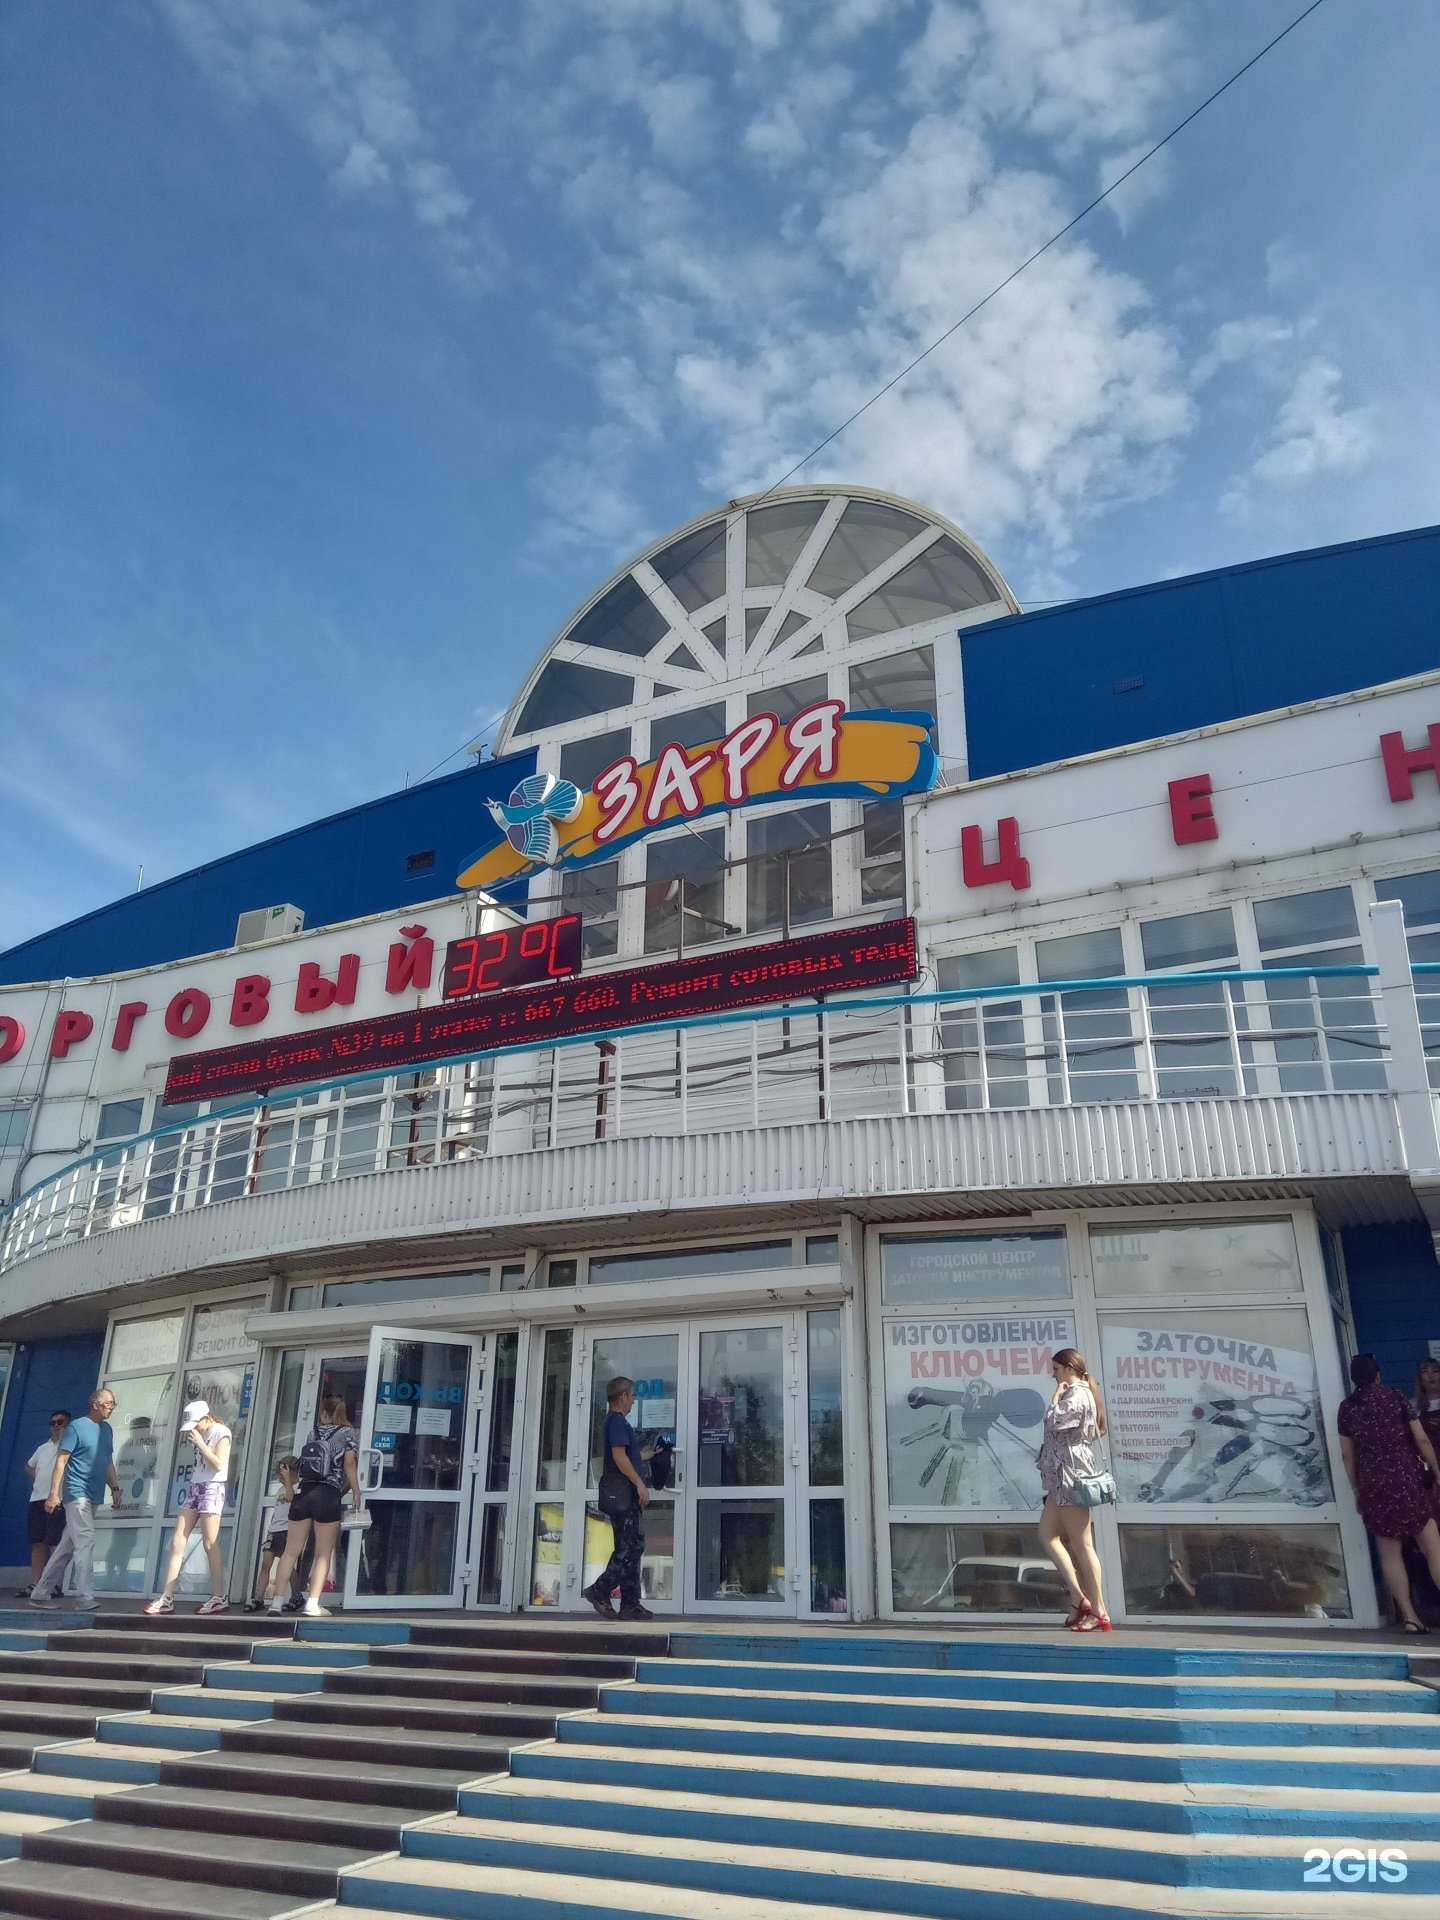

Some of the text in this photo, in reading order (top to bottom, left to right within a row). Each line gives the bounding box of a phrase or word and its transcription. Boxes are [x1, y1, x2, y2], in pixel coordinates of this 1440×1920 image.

[592, 698, 846, 843] ЗАРЯ
[631, 973, 723, 1004] Ремонт
[729, 953, 844, 986] сотовых
[909, 1250, 1037, 1269] ГОРОДСКОЙ ЦЕНТР
[892, 1319, 1068, 1346] ИЗГОТОВЛЕНИЕ
[1137, 1331, 1278, 1373] ЗАТОЧКА
[1116, 1355, 1297, 1397] ИНСТРУМЕНТА
